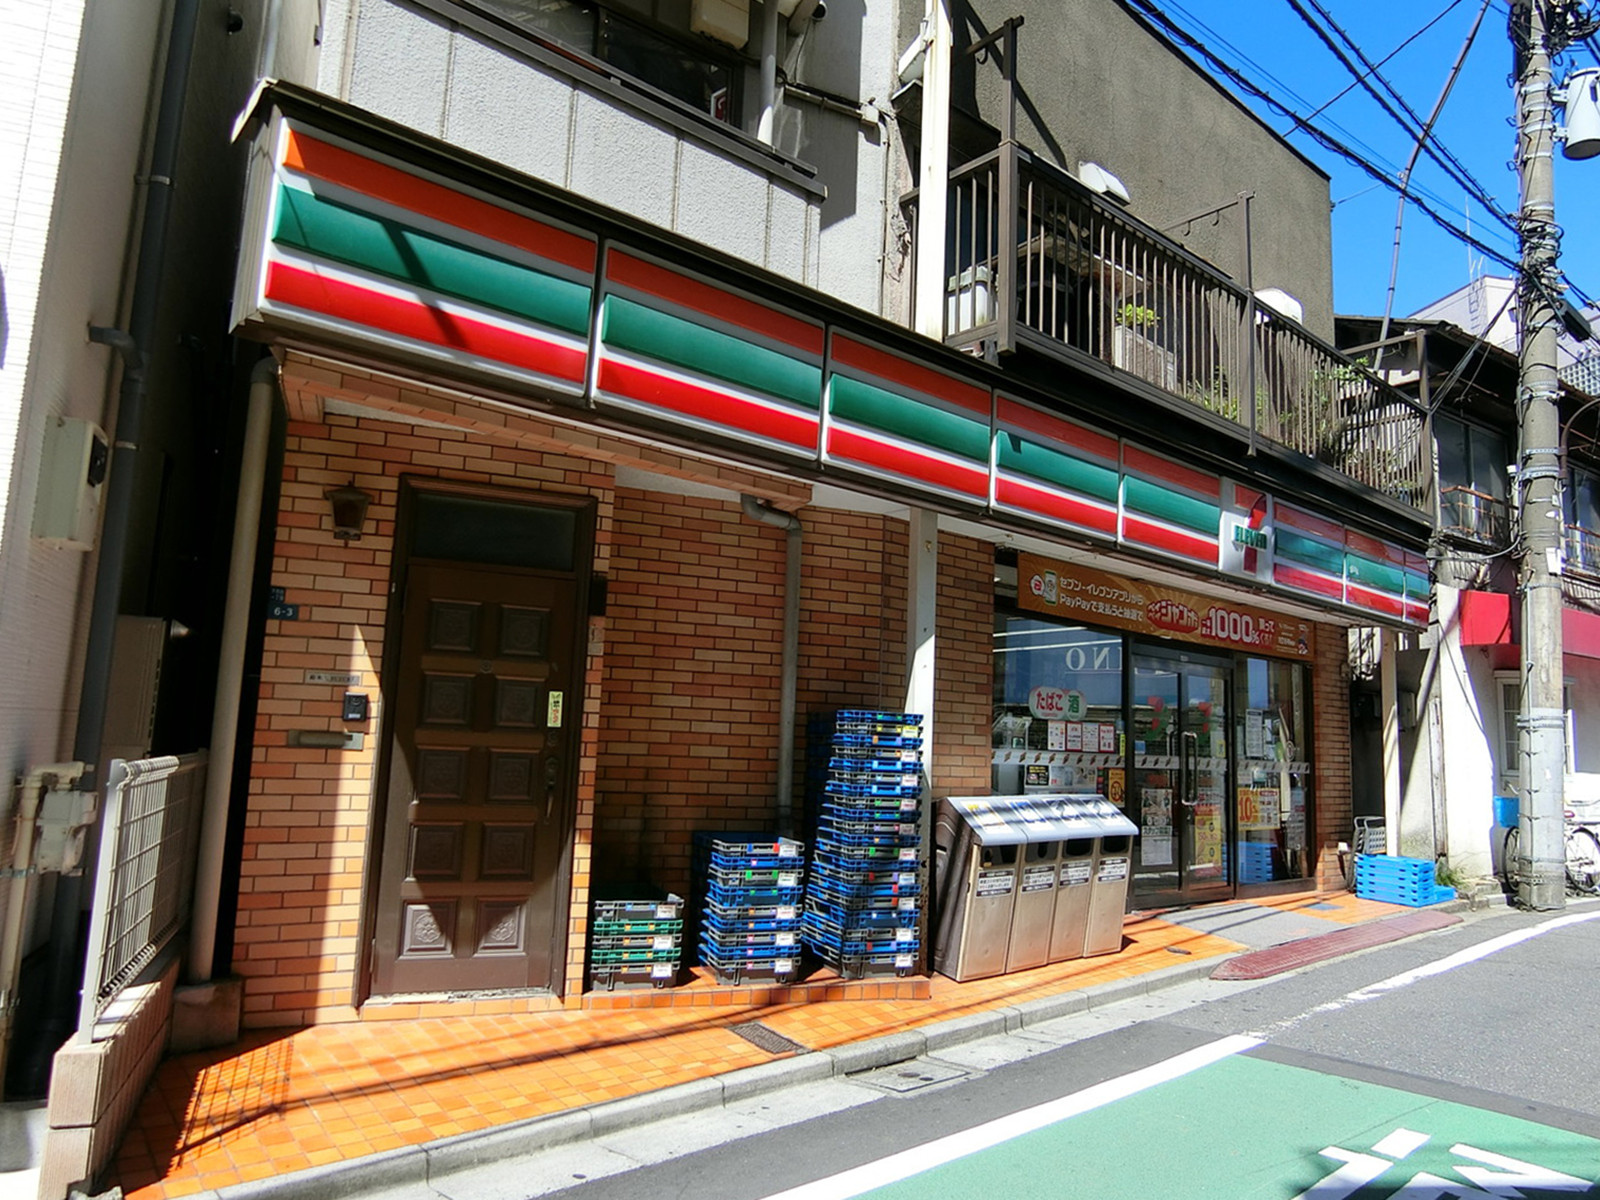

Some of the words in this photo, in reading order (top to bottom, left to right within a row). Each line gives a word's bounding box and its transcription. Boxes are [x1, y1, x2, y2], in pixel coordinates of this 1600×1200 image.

[274, 606, 294, 617] 6-3
[1036, 690, 1063, 712] たばこ
[1067, 694, 1080, 714] 酒
